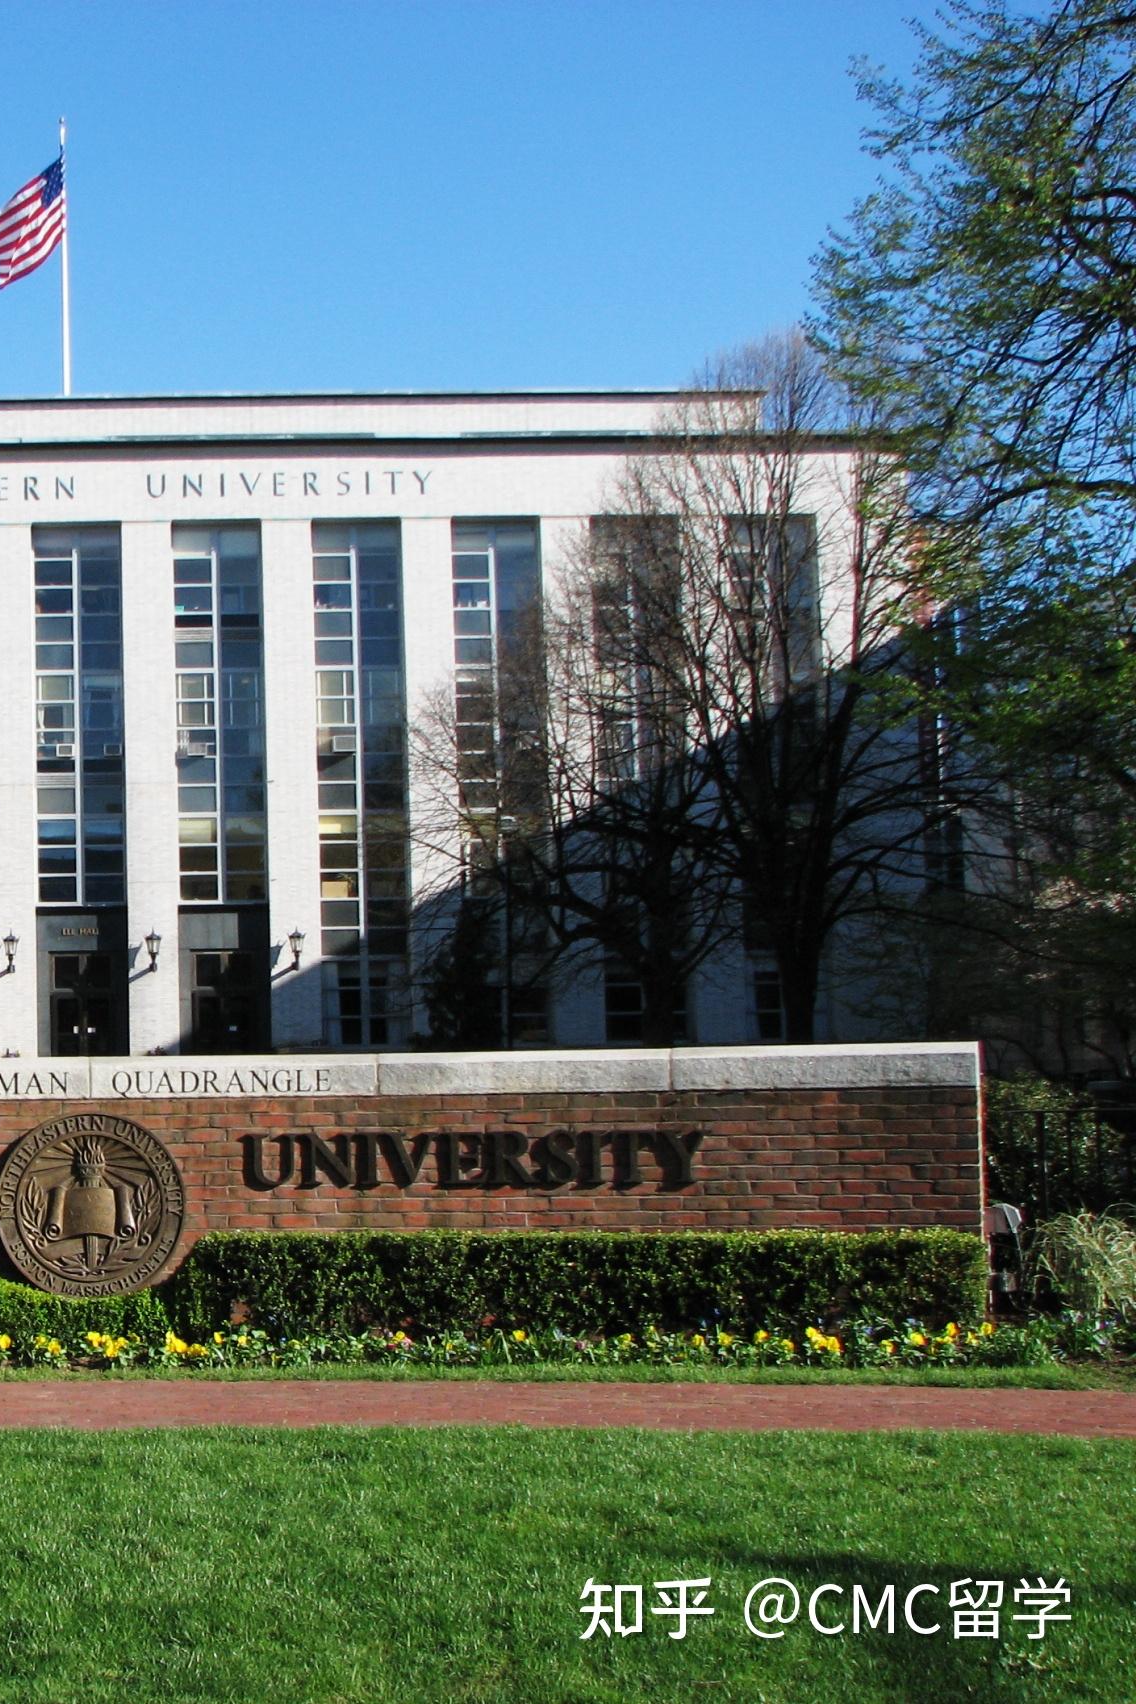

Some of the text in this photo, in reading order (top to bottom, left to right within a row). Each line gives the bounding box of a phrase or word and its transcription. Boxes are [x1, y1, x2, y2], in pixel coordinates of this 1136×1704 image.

[146, 469, 433, 499] UNIVERSITY
[111, 1069, 332, 1098] QUADRANGLE
[0, 1115, 105, 1221] NORTHEASTERN
[115, 1121, 183, 1217] UNIVERSITY
[237, 1129, 705, 1192] UNIVERSITY
